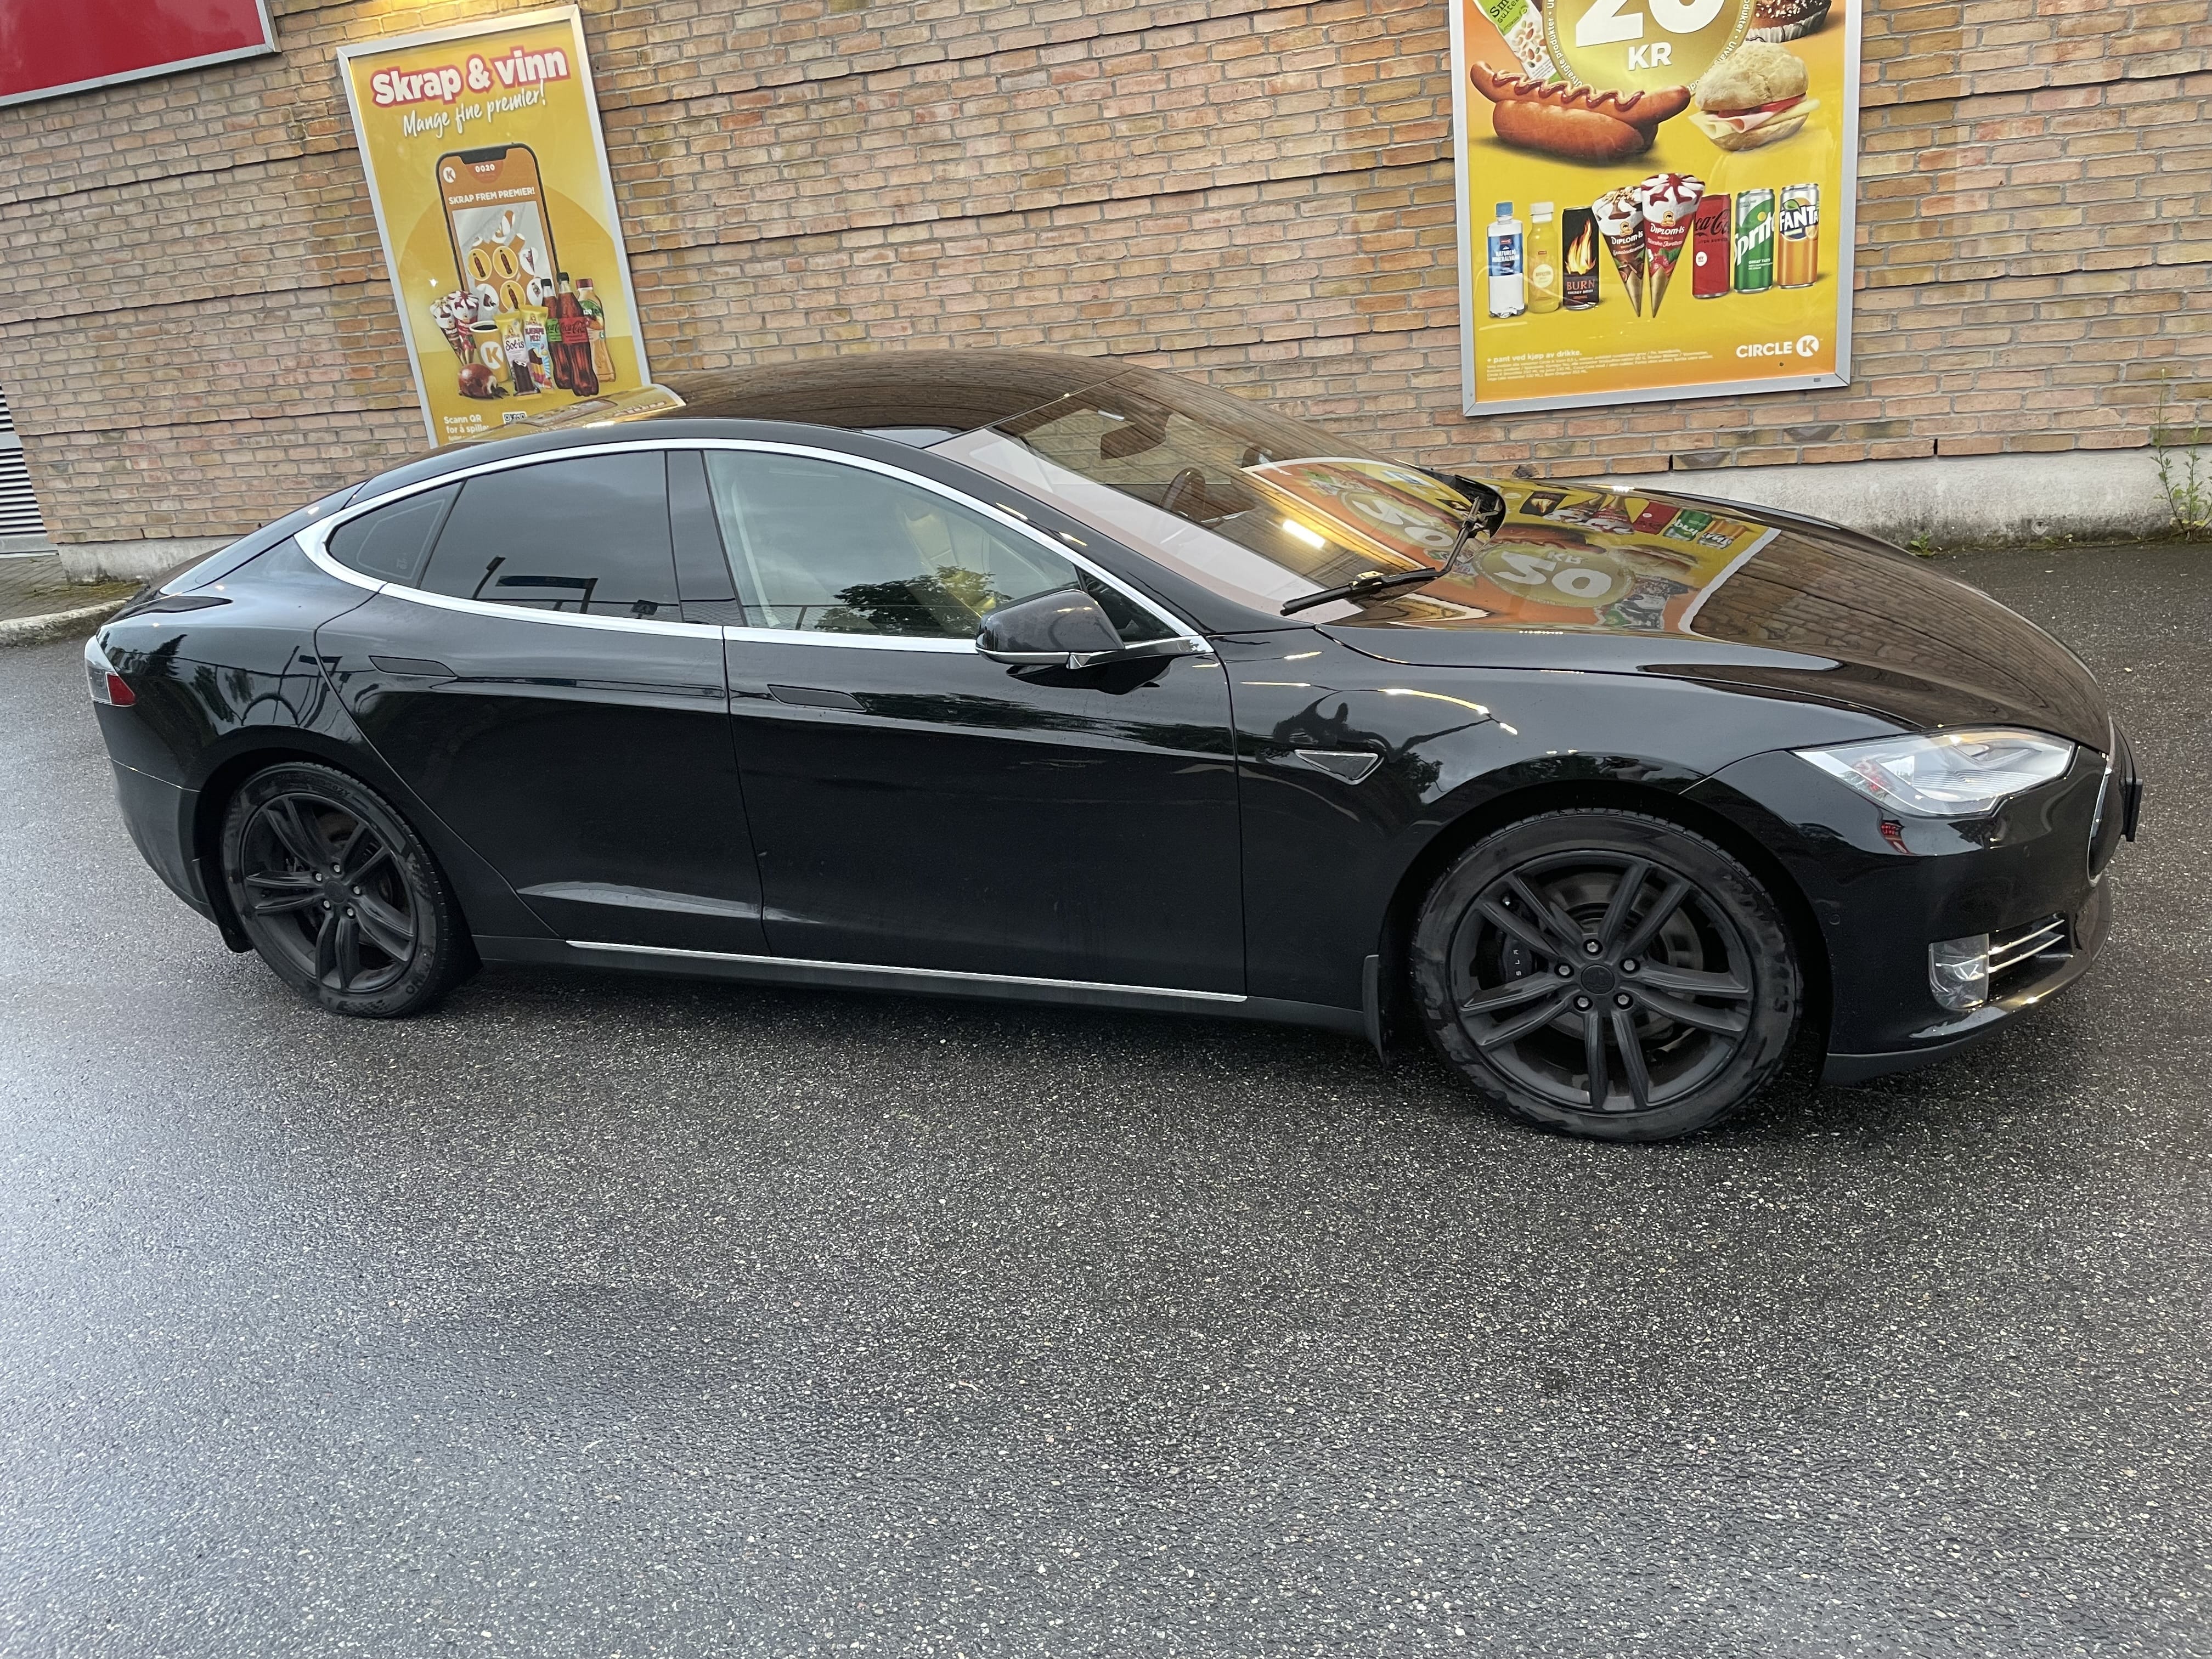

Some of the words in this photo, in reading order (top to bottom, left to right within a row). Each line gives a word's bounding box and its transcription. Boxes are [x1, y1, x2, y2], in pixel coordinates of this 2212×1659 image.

[1736, 0, 1750, 33] odukter
[1628, 42, 1672, 70] KR
[373, 69, 462, 104] Skrap
[468, 58, 492, 90] &
[494, 50, 567, 84] vinn
[403, 110, 450, 138] Mange
[455, 104, 482, 134] fine
[487, 78, 546, 123] premier!
[448, 195, 474, 205] SKRAP
[476, 191, 497, 201] FREM
[498, 187, 535, 199] PREMIER!
[1780, 206, 1818, 232] FANTA
[1566, 280, 1595, 291] BURN
[1736, 341, 1793, 358] CIRCLE
[1799, 338, 1818, 357] K
[1493, 356, 1510, 364] pant
[444, 416, 469, 424] Scann
[470, 414, 482, 422] QR
[446, 425, 458, 433] for
